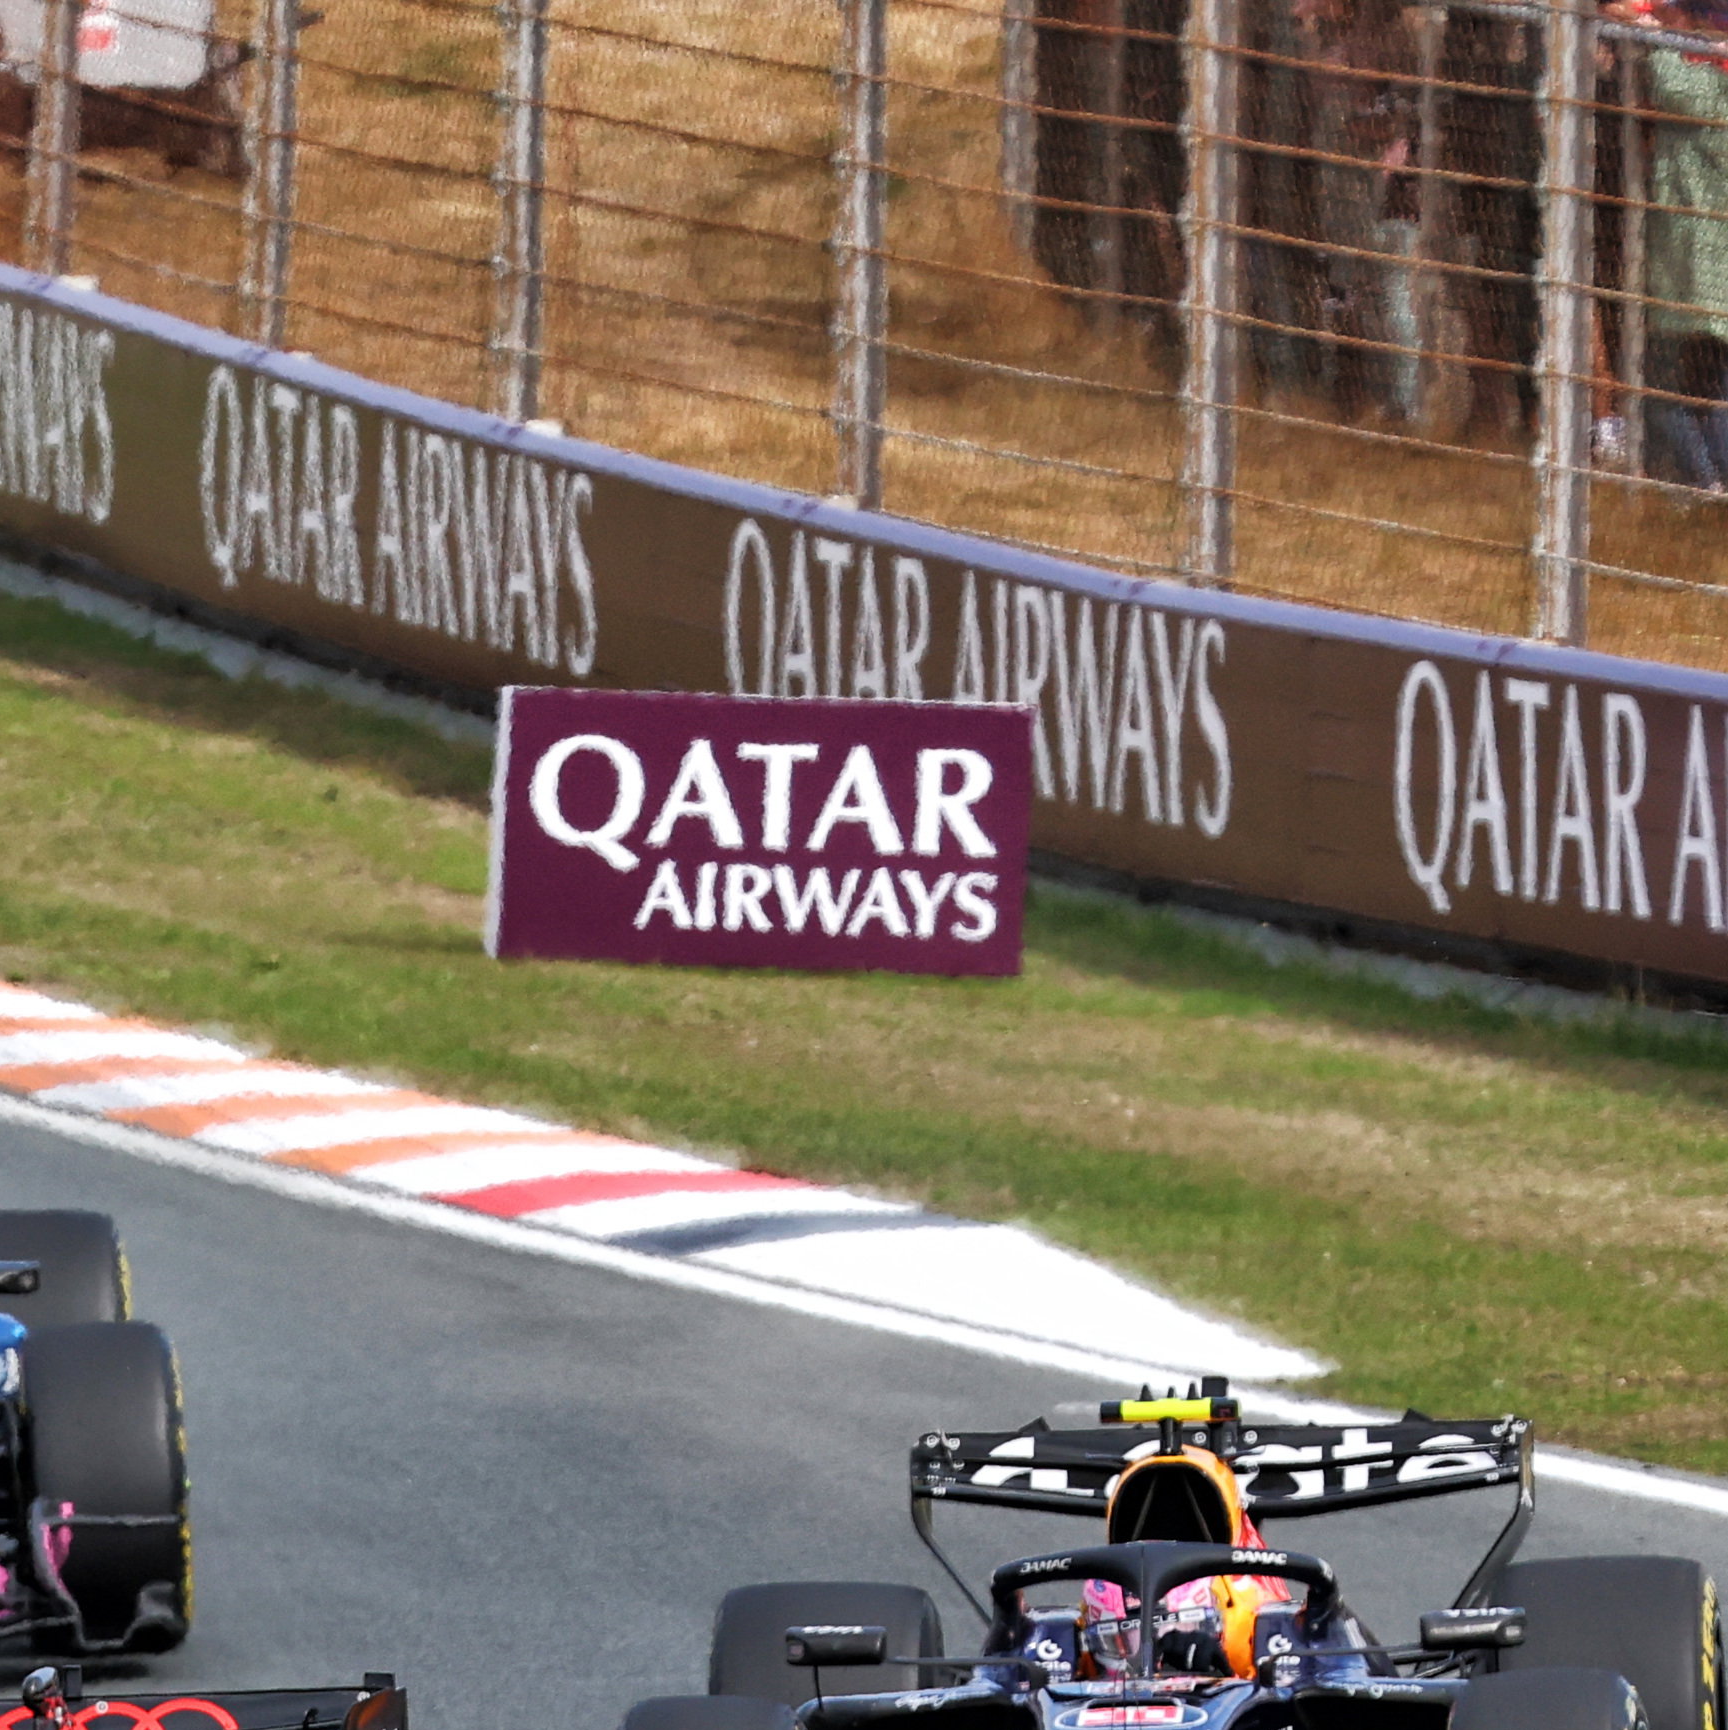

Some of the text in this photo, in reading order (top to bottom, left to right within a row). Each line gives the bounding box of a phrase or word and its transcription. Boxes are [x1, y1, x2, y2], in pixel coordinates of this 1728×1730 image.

[200, 362, 598, 677] QATAR AIRWAYS
[723, 518, 1233, 839] QATAR AIRWAYS
[529, 734, 997, 873] QATAR
[1393, 659, 1652, 920] QATAR
[634, 860, 999, 943] AIRWAYS
[1019, 1557, 1072, 1573] DAMAC
[1231, 1550, 1288, 1566] DAMAC
[1120, 1611, 1178, 1630] ORCLE
